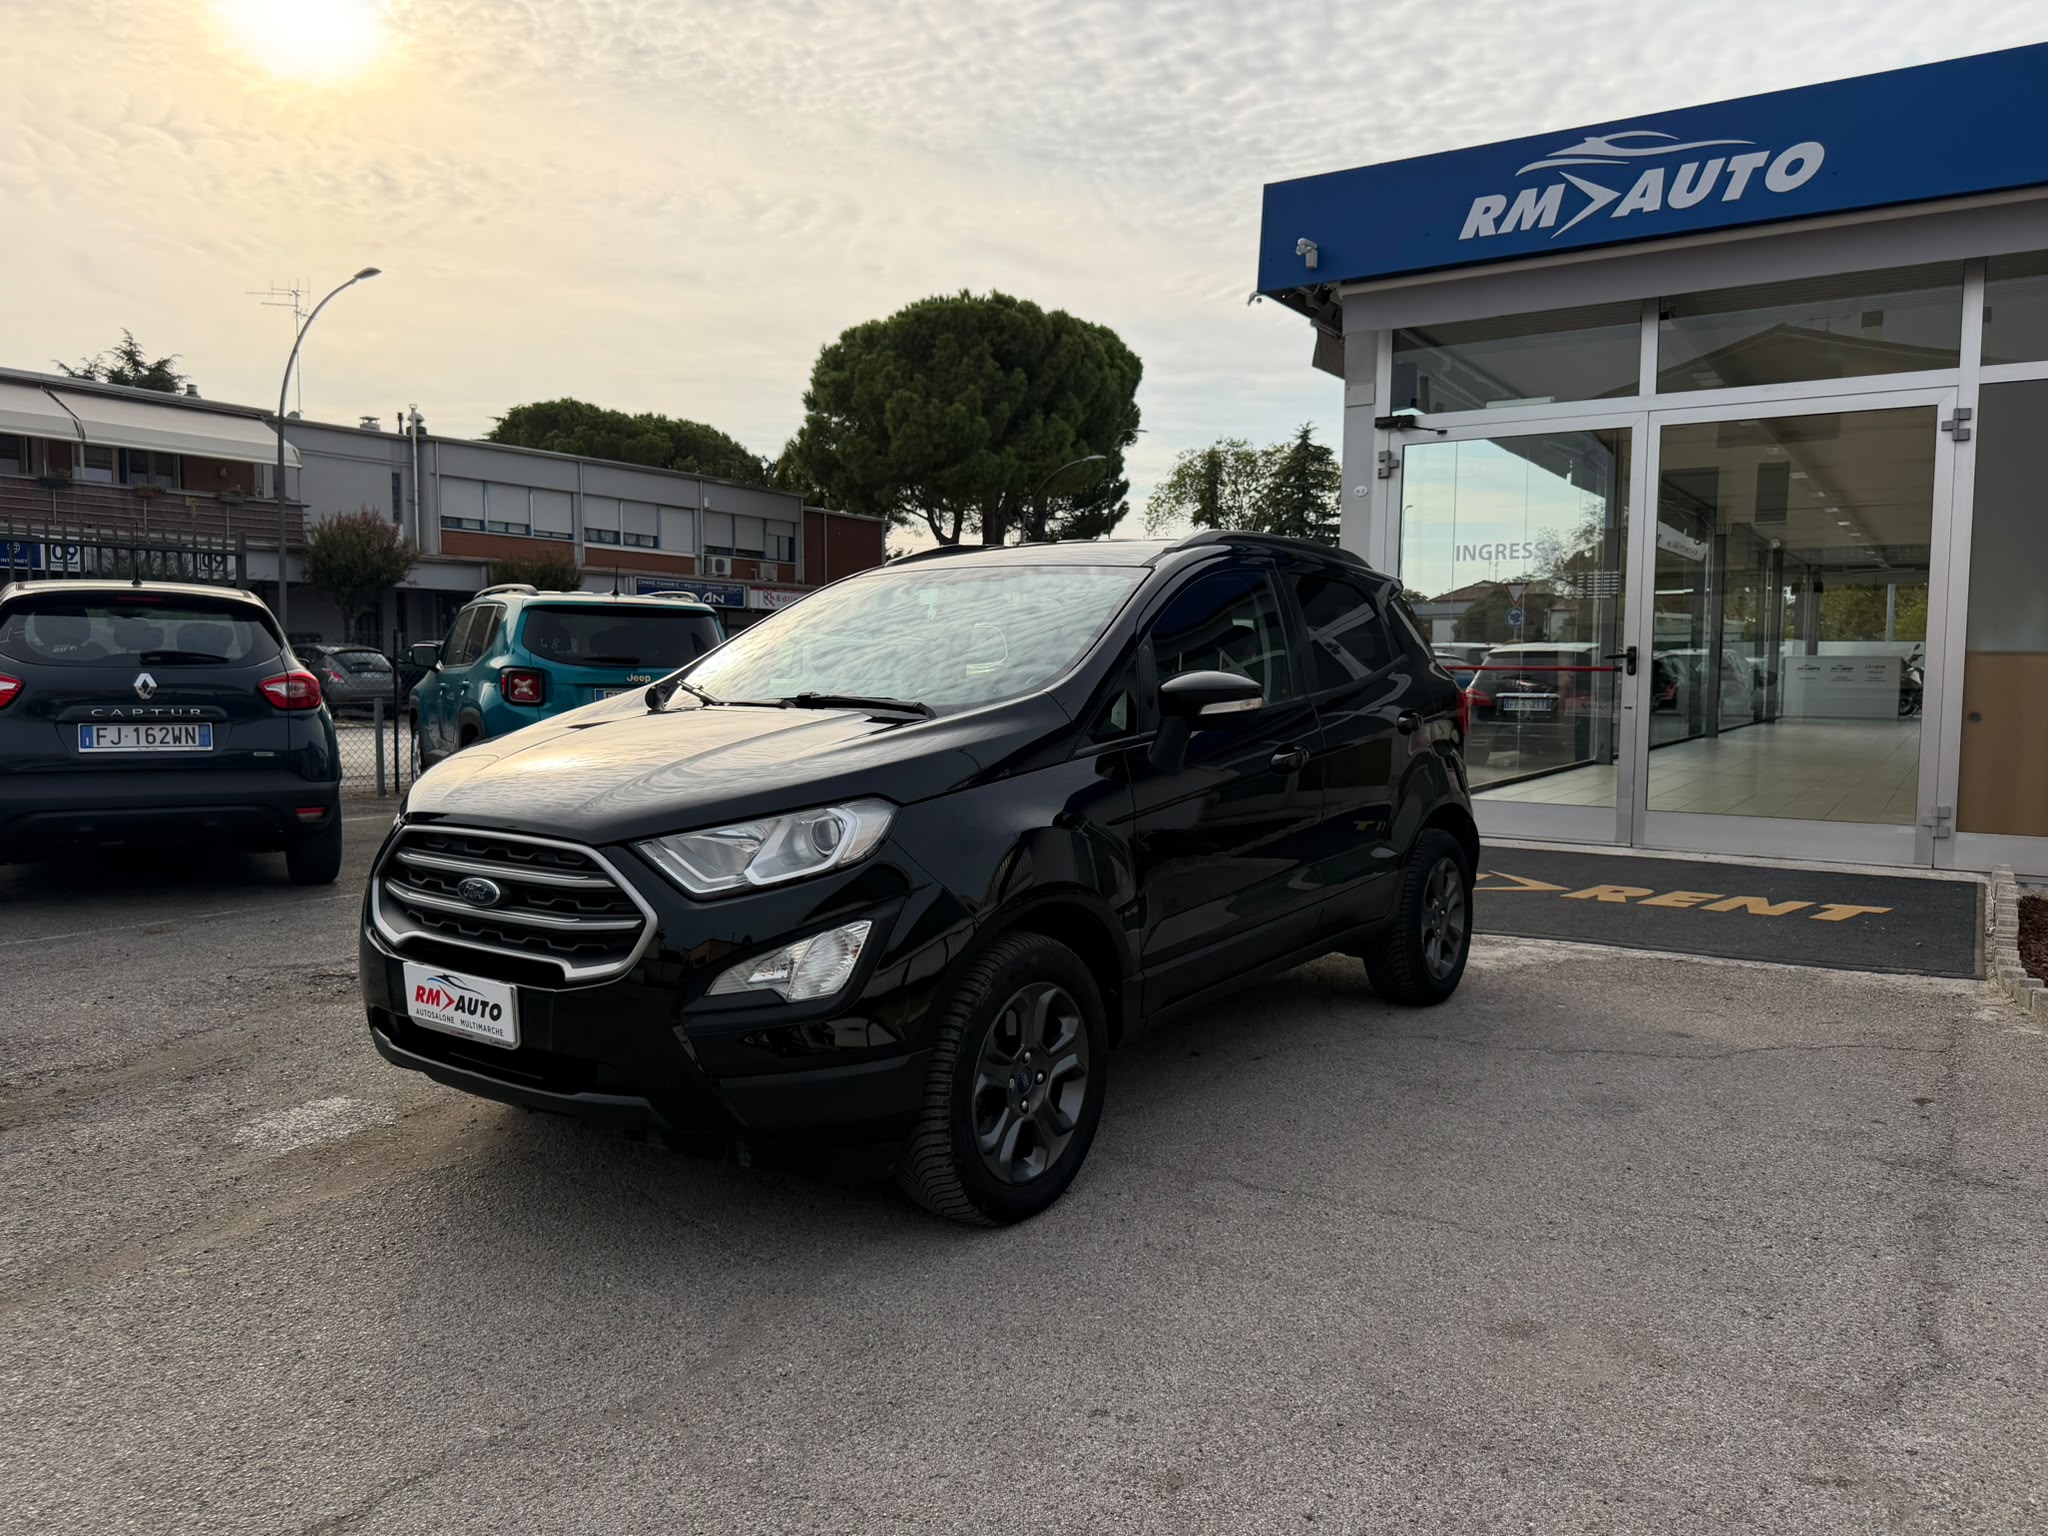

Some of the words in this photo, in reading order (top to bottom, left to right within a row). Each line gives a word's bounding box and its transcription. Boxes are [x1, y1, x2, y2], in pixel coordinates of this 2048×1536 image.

[1610, 141, 1825, 218] AUTO
[626, 673, 652, 683] Jeep
[90, 708, 201, 717] CAPTUR
[463, 881, 488, 900] Ford
[1560, 884, 1895, 921] RENT
[415, 1007, 455, 1024] AUTOSALONE
[460, 1019, 505, 1037] MULTIMARCHE
[454, 995, 503, 1022] AUTO
